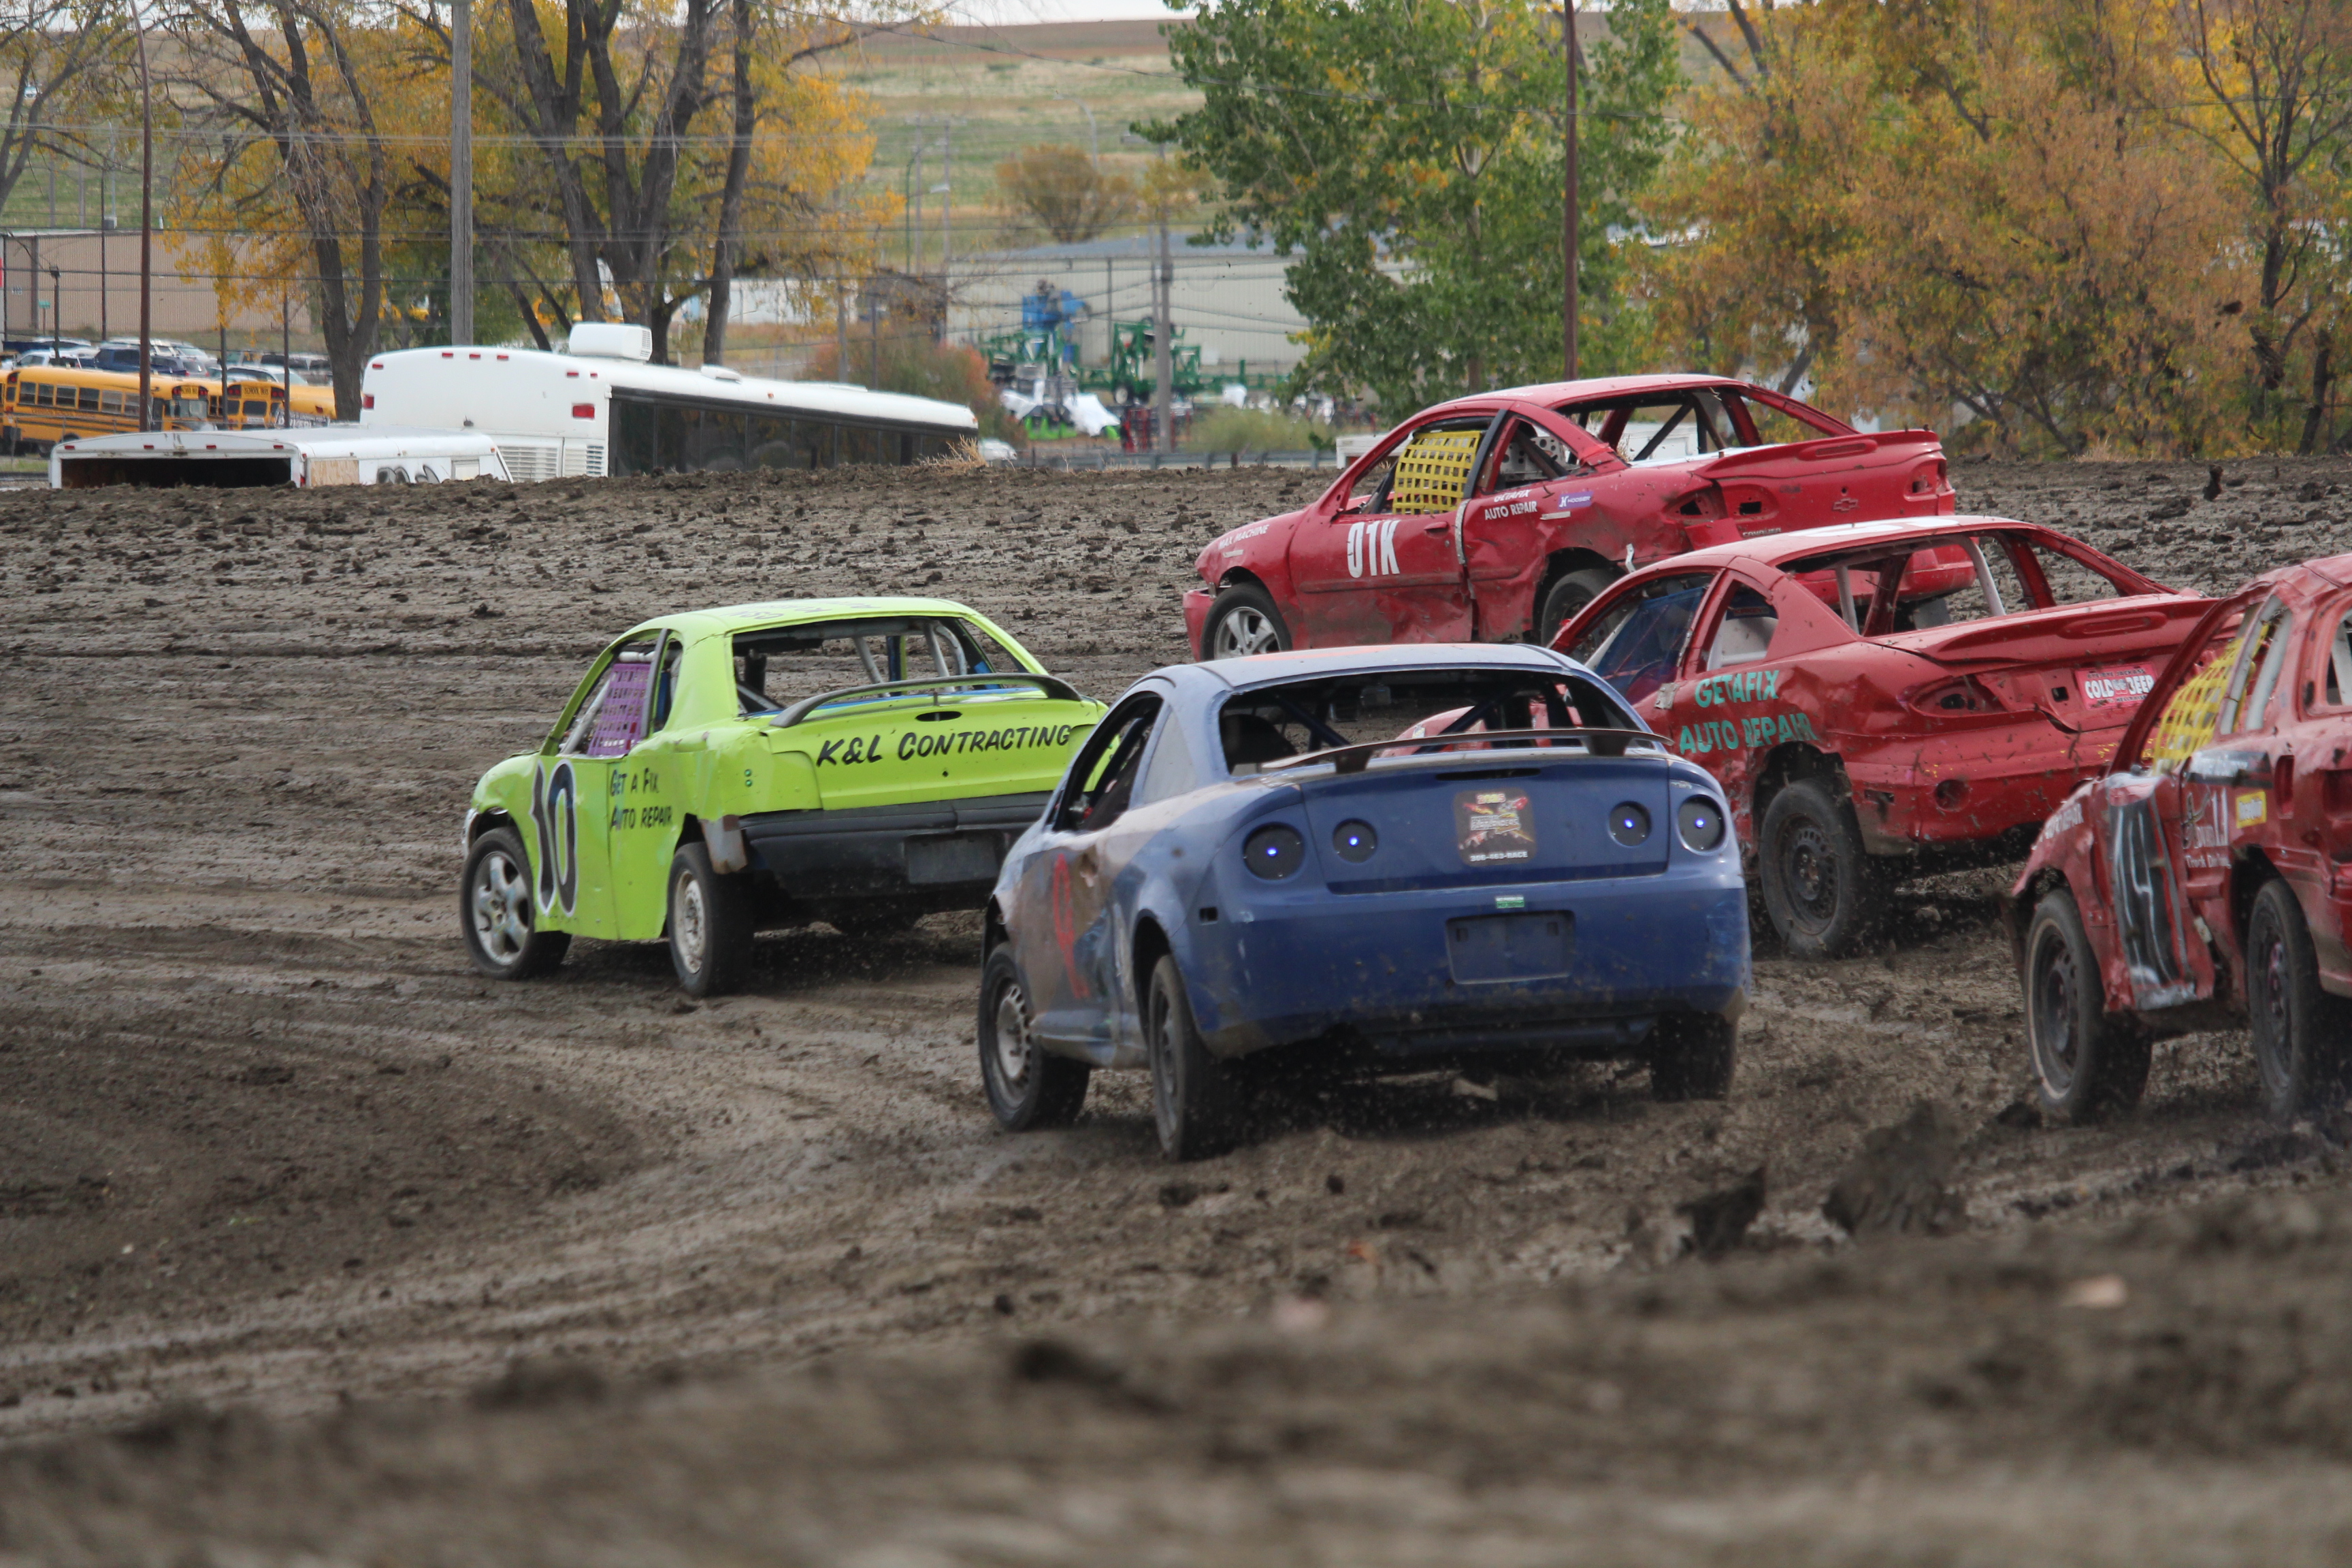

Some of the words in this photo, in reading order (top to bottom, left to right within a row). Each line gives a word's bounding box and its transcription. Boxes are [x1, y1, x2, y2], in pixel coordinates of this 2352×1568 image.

[1494, 489, 1532, 502] GETAFIX
[1484, 506, 1509, 521] AUTO
[1510, 501, 1537, 516] REPAIR
[1235, 524, 1270, 542] MACHINE
[1347, 519, 1401, 579] 01K
[1695, 670, 1780, 708] GETAFIX
[2085, 679, 2114, 699] COLD
[817, 734, 883, 767] K&L
[897, 724, 1071, 761] CONTRACTING
[1679, 720, 1739, 755] AUTO
[1742, 713, 1820, 748] REPAIR
[630, 773, 638, 794] A
[640, 804, 672, 829] REPAIR
[528, 758, 578, 918] 10
